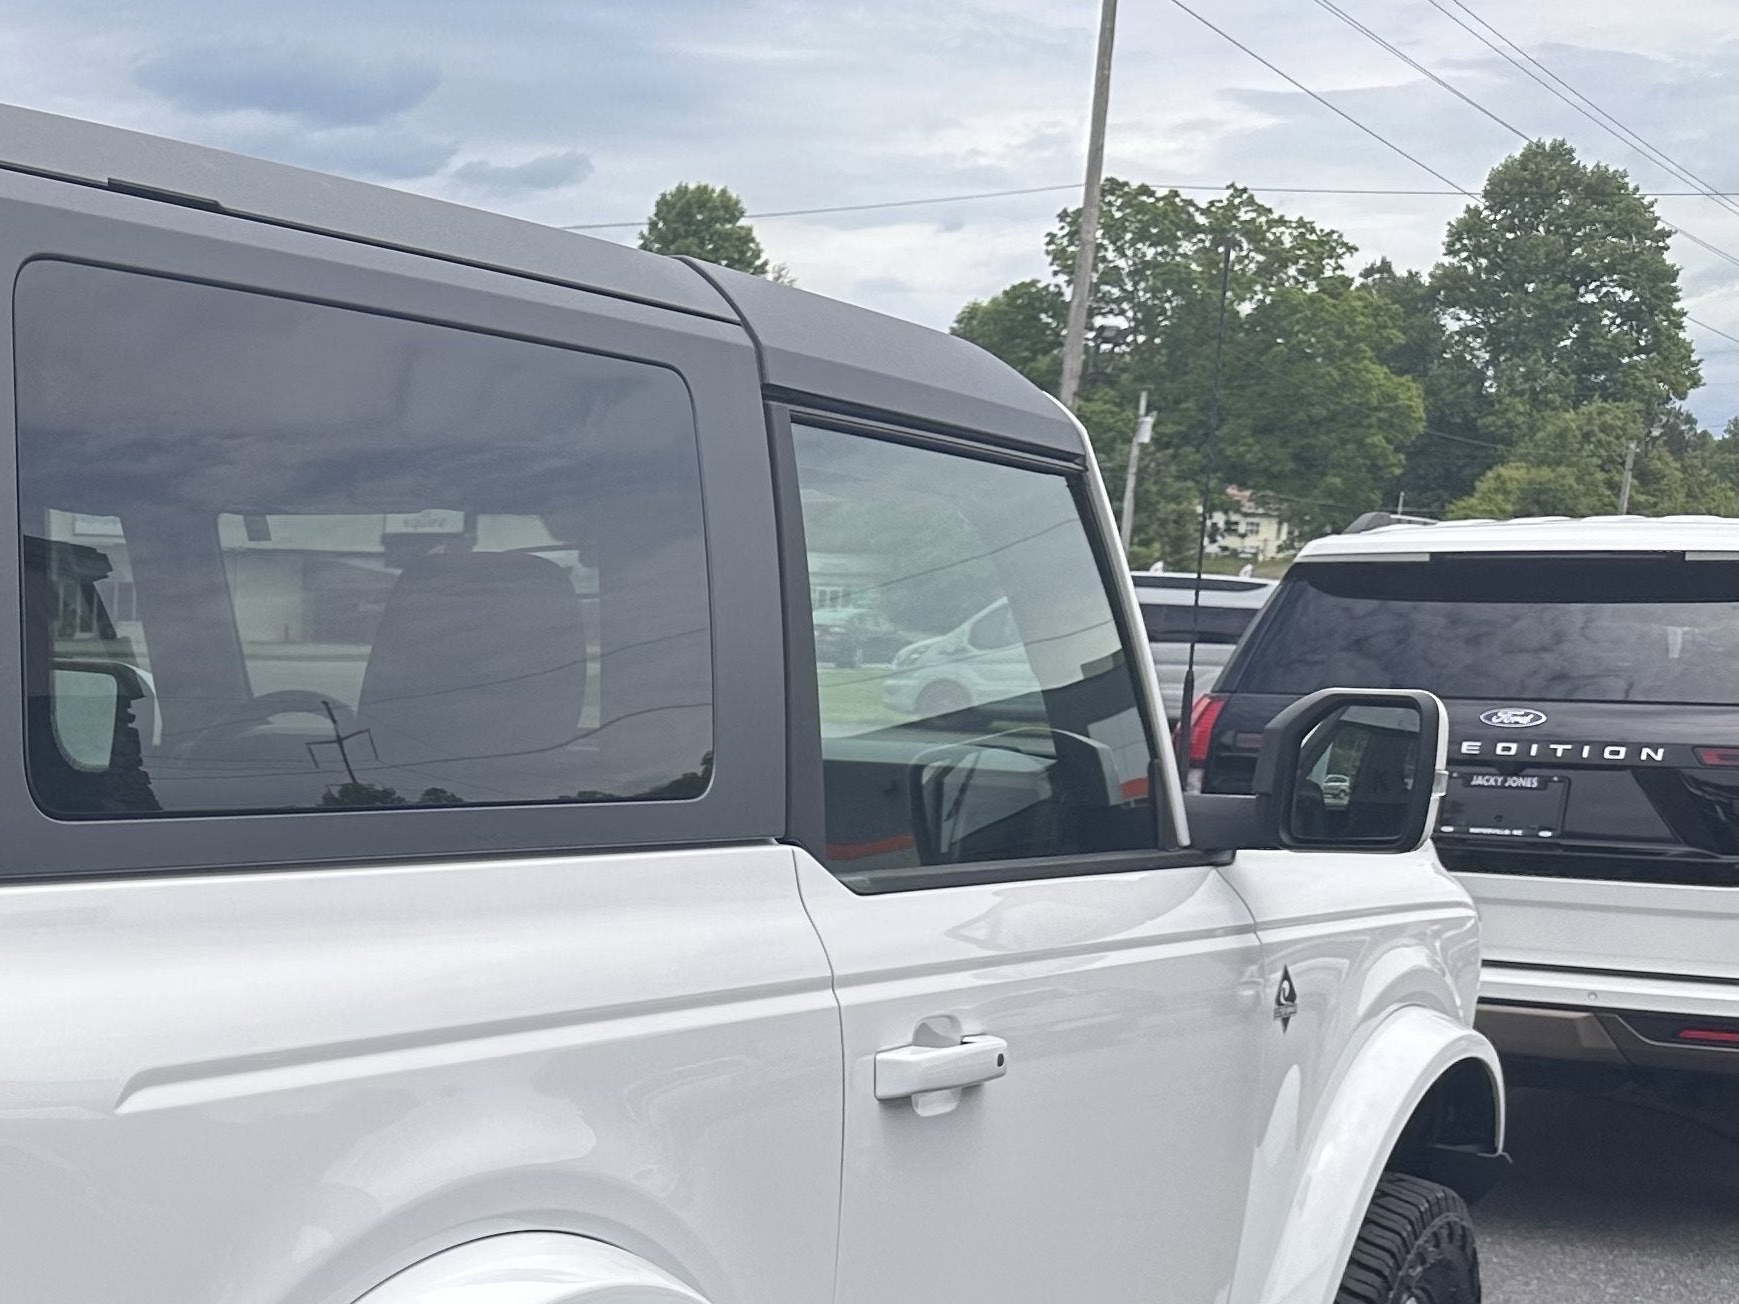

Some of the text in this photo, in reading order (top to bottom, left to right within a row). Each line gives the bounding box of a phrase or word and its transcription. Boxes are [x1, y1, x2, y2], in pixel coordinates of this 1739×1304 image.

[1460, 740, 1665, 762] EDITION
[1470, 774, 1539, 788] JACKY JONES
